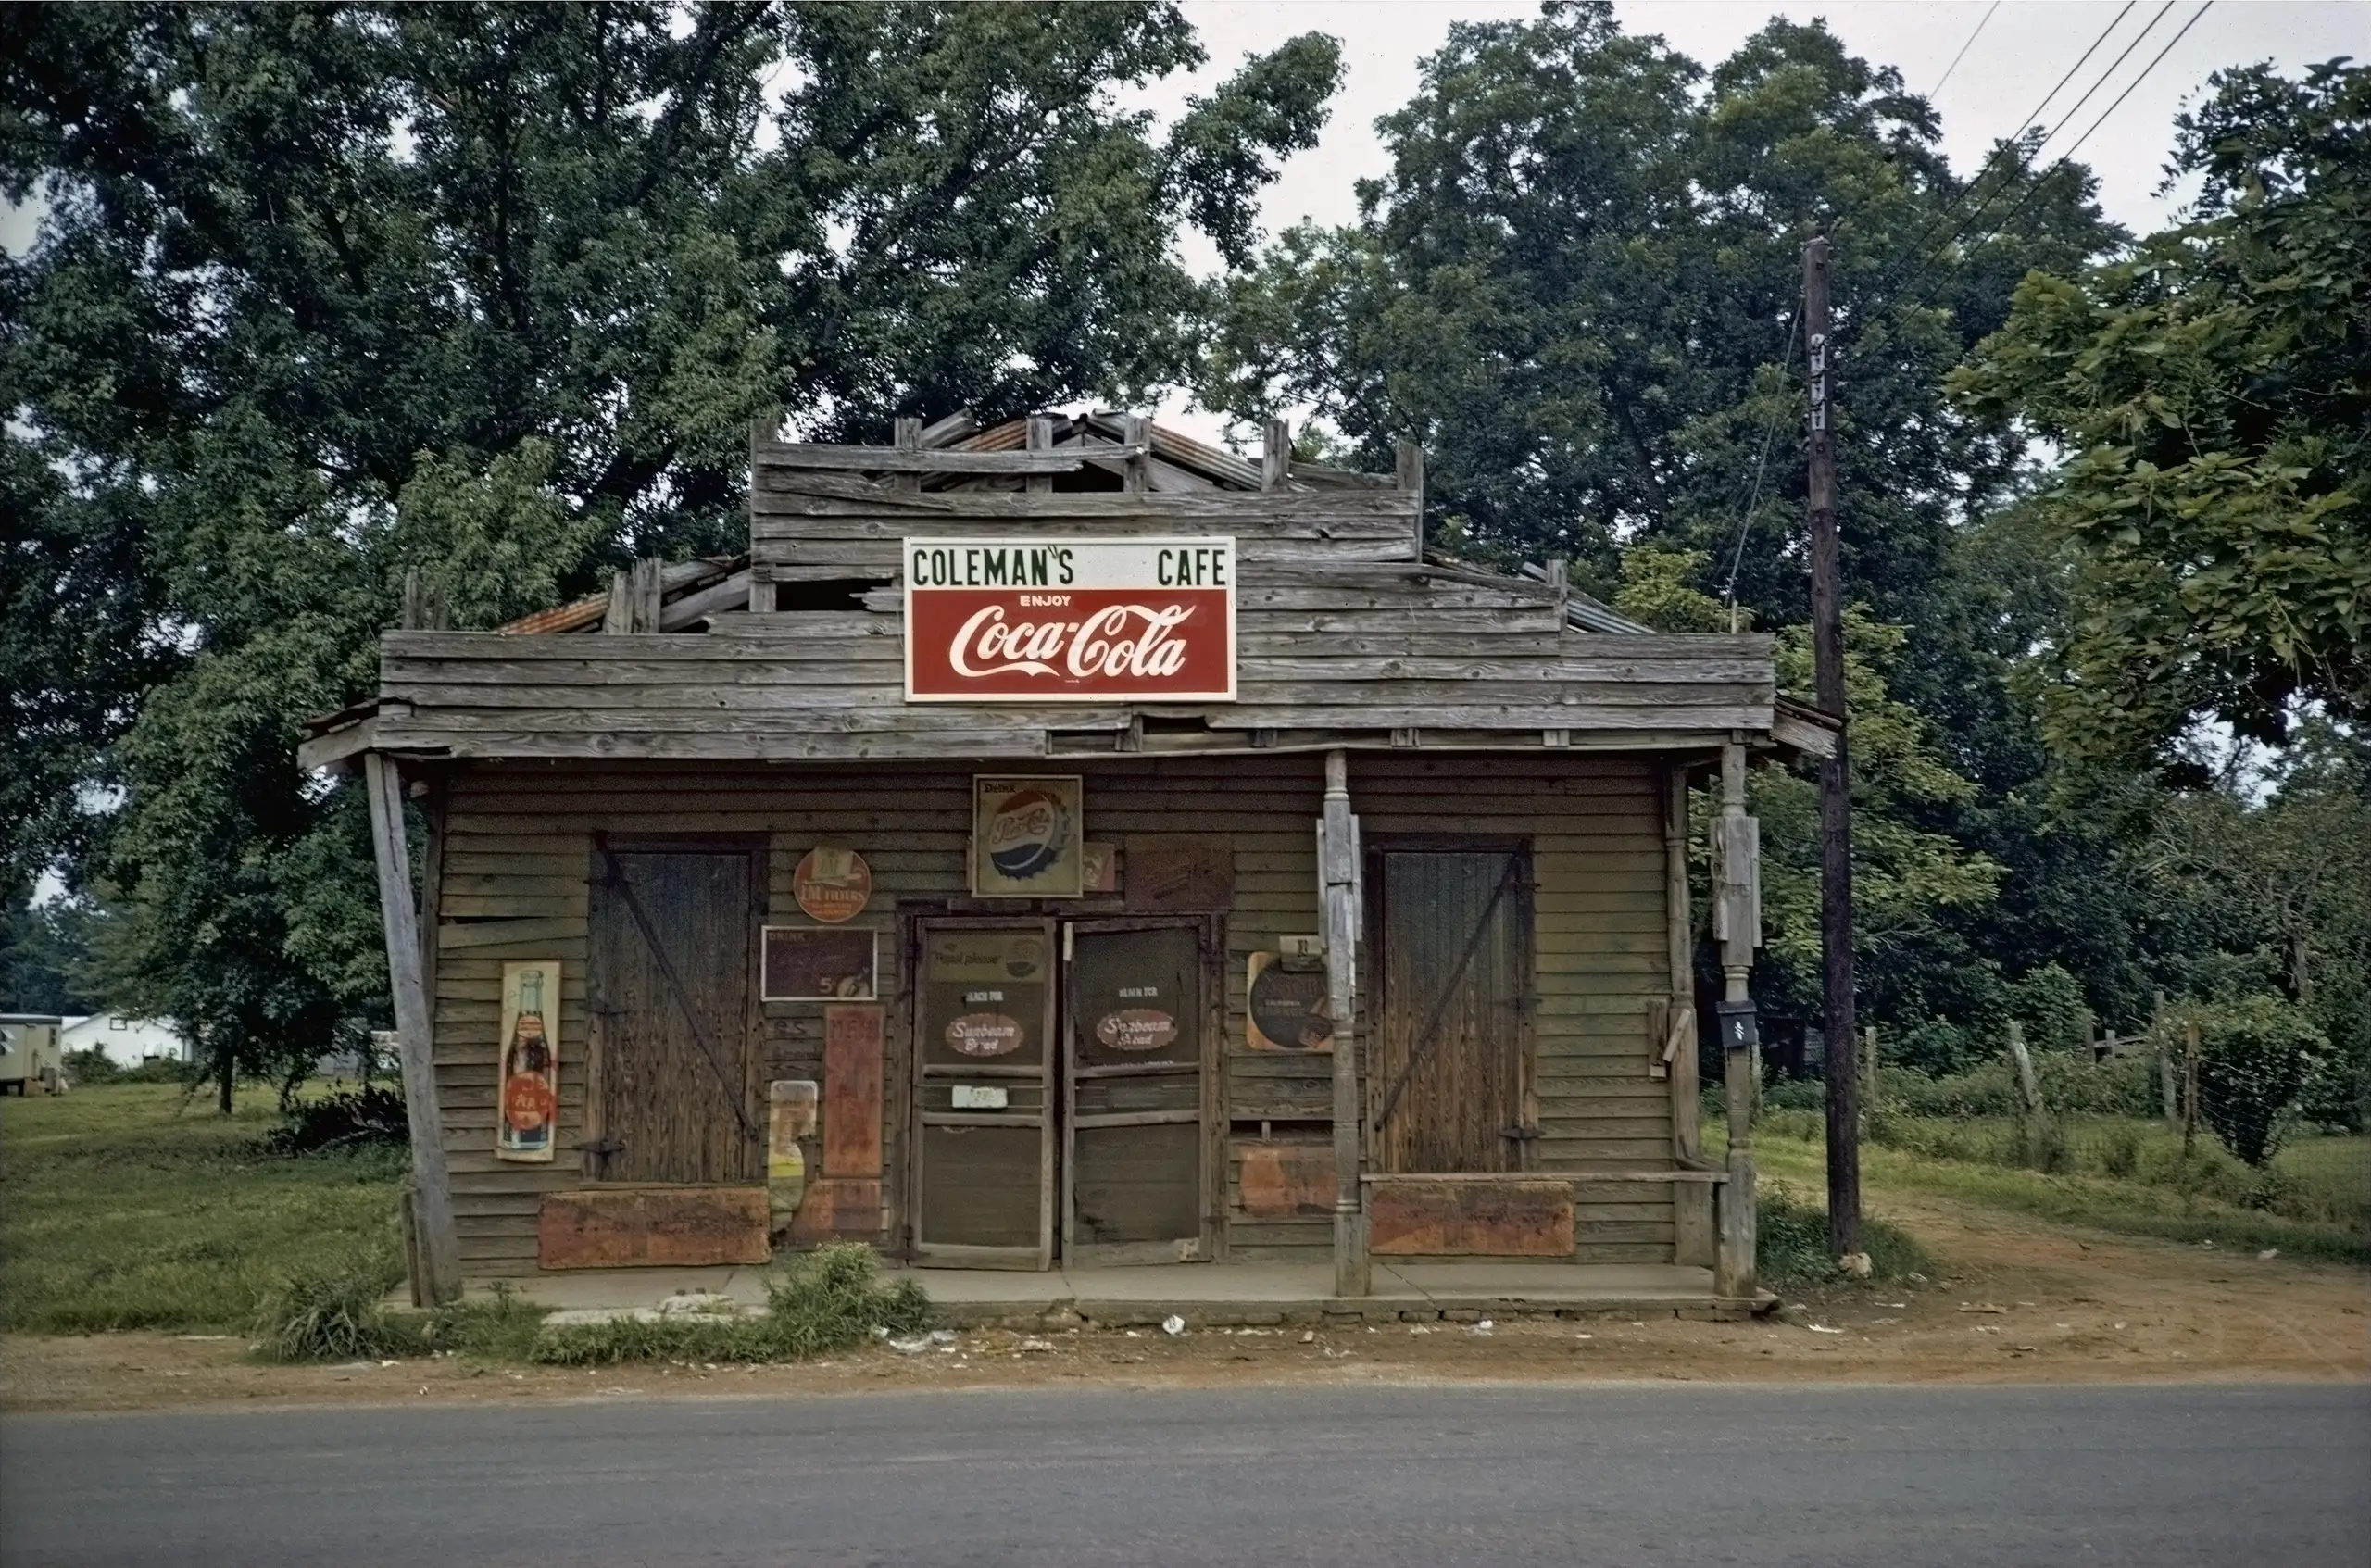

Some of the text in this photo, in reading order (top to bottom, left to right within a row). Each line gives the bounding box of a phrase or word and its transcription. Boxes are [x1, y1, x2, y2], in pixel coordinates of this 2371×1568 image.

[1158, 549, 1226, 585] CAFE
[1020, 595, 1072, 607] ENJOY
[949, 604, 1197, 677] Coca-Cola
[768, 932, 805, 941] DRINK
[952, 1022, 1015, 1037] Sunbeam
